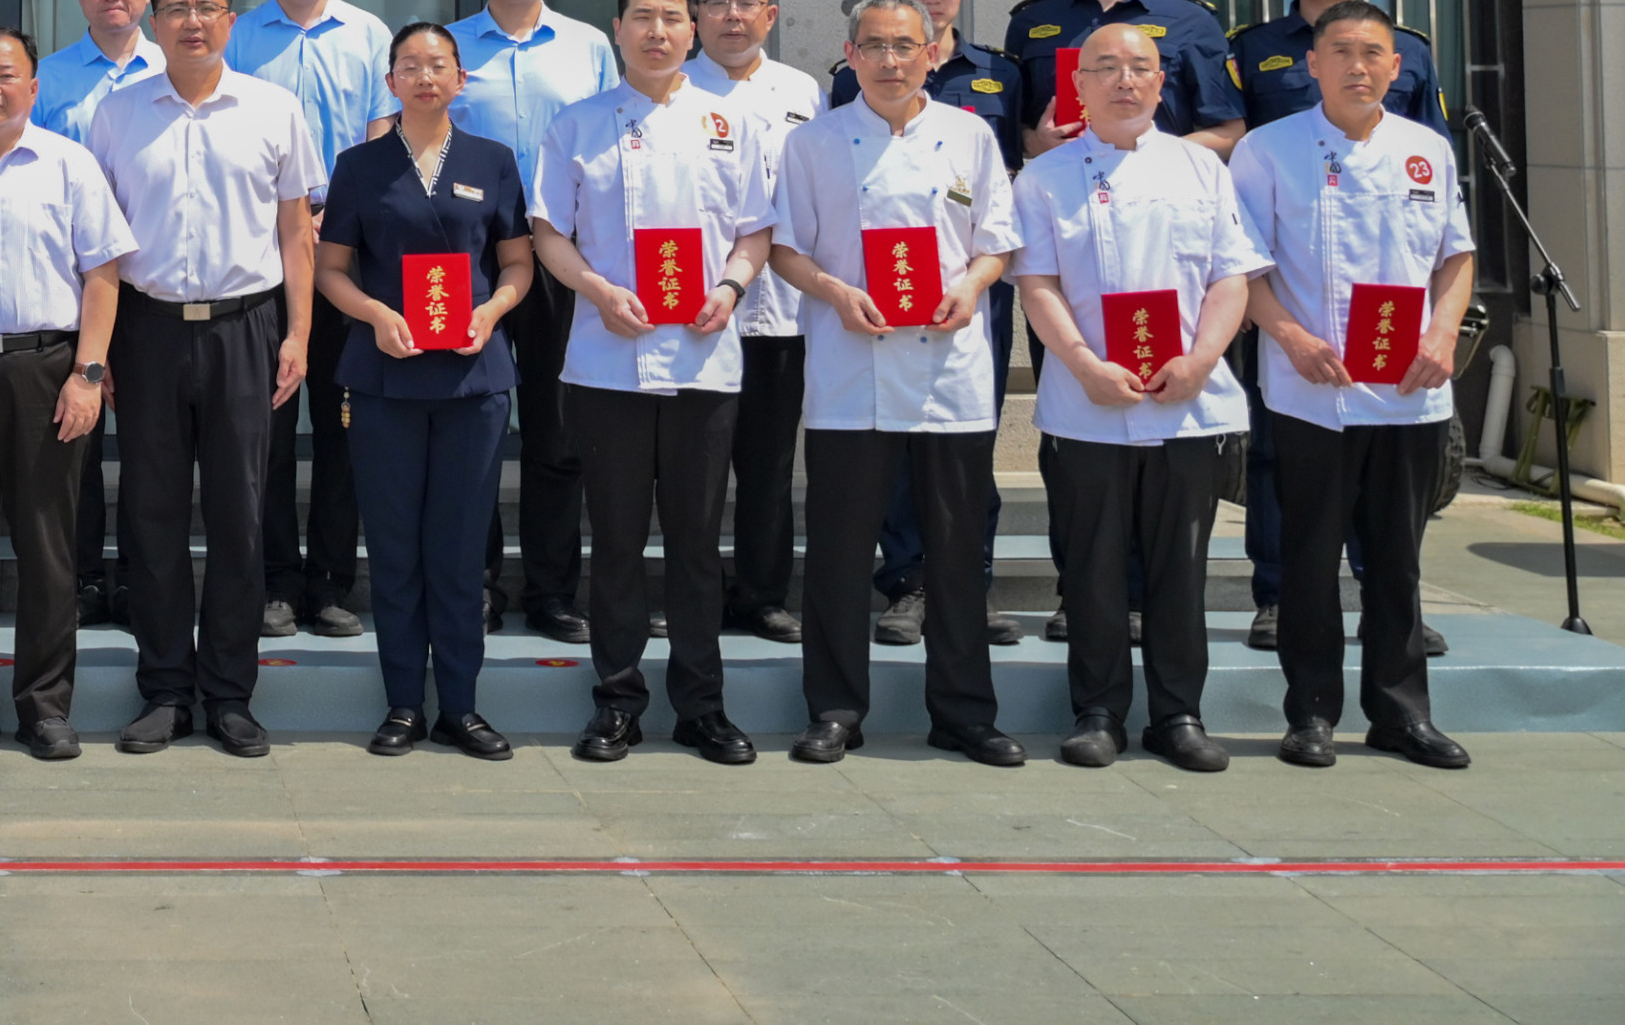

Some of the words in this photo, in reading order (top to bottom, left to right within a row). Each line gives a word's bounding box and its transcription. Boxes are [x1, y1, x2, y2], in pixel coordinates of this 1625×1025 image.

[1409, 161, 1431, 179] 23
[424, 265, 450, 335] 荣誉证书
[657, 239, 683, 311] 荣誉证书
[892, 240, 914, 312] 荣誉证书
[1132, 307, 1154, 380] 荣誉证书
[1371, 300, 1395, 372] 荣誉证书
